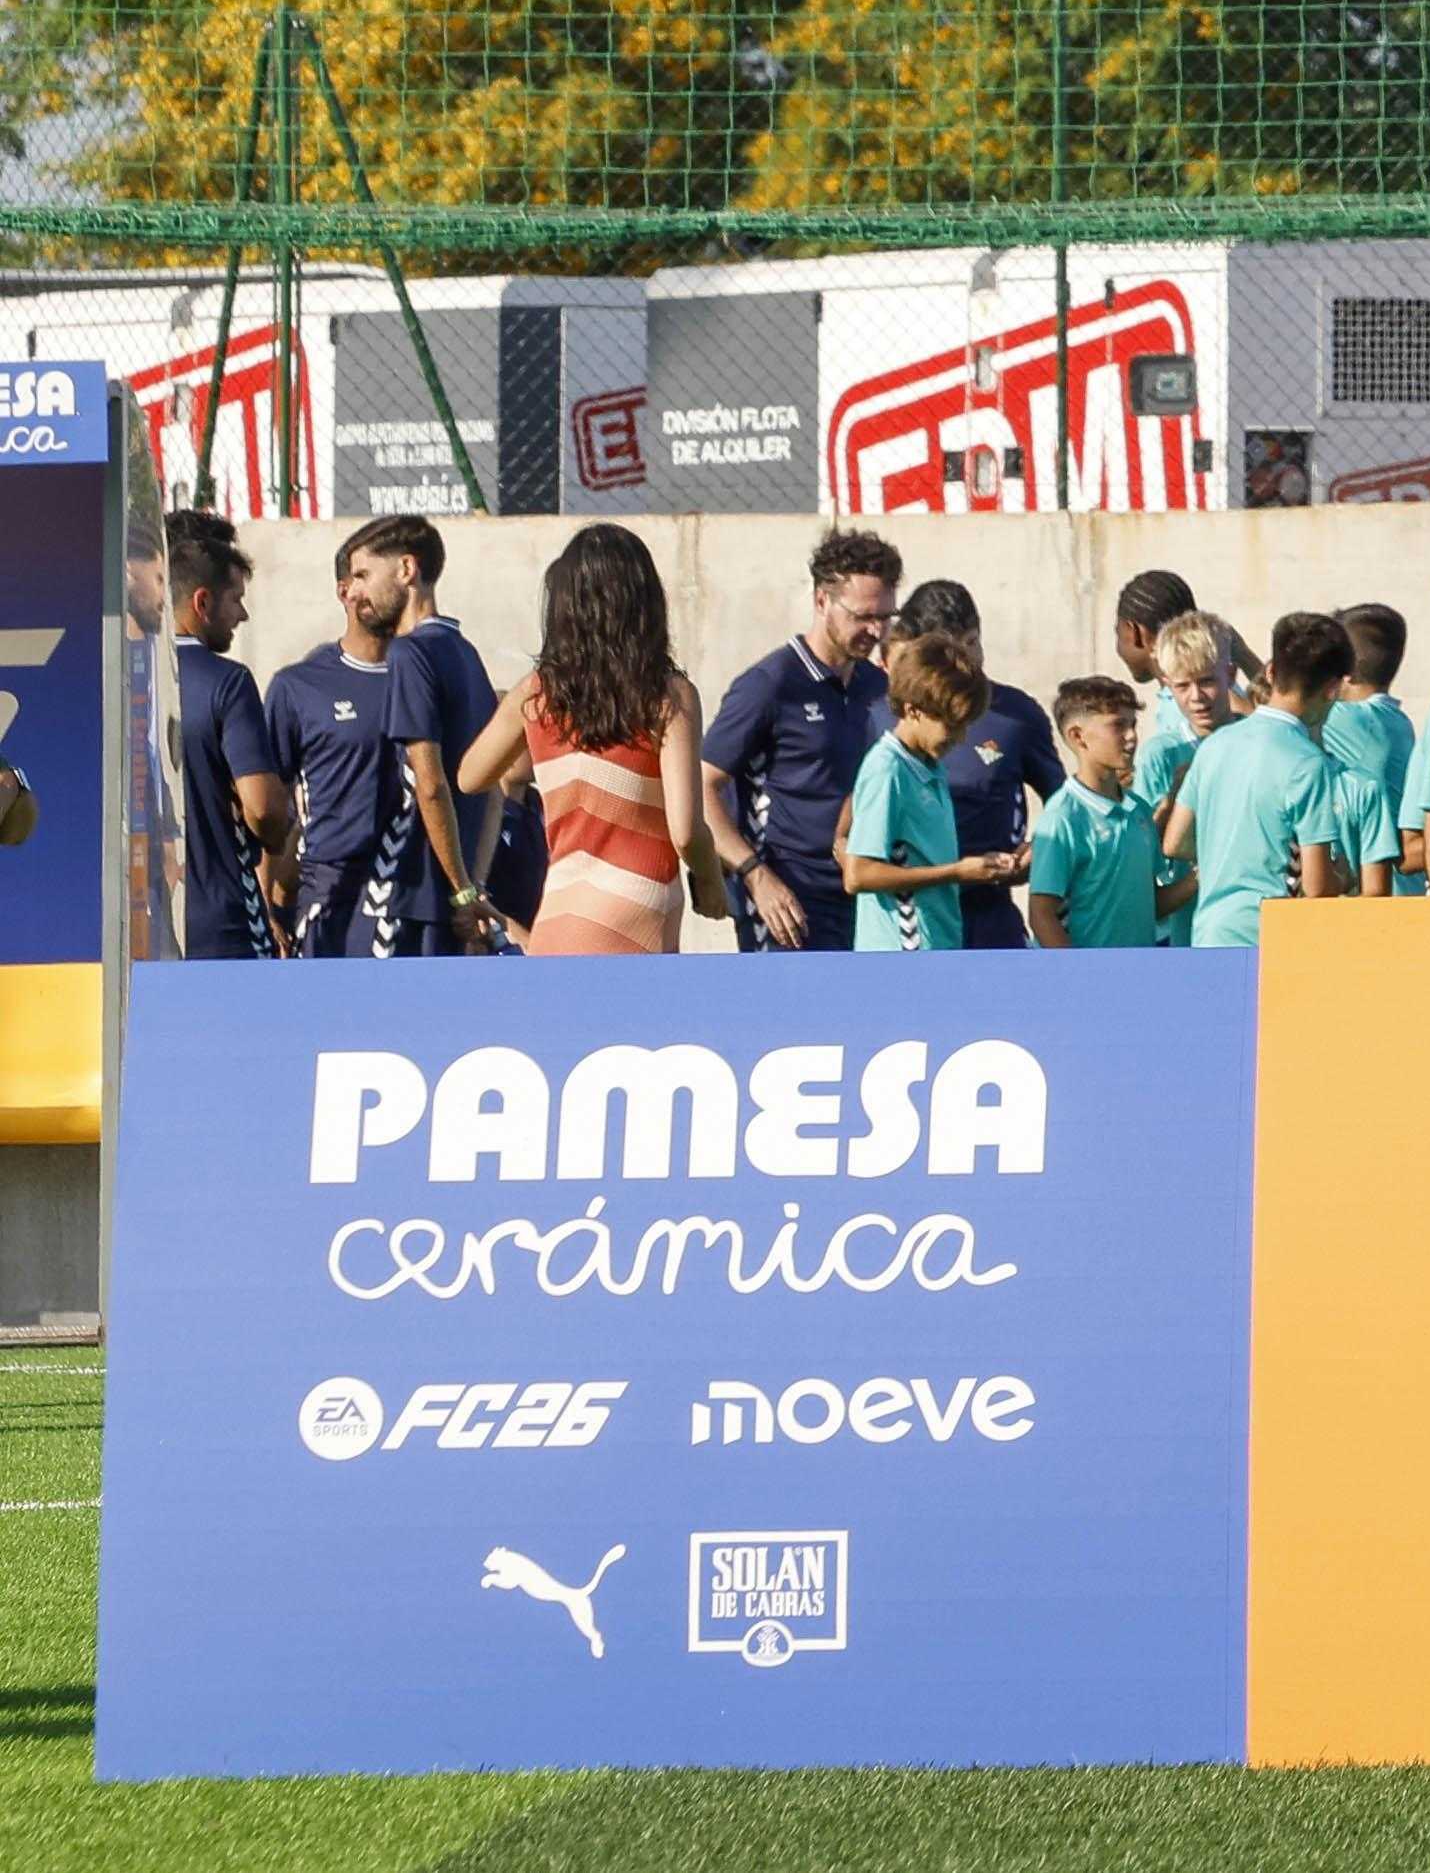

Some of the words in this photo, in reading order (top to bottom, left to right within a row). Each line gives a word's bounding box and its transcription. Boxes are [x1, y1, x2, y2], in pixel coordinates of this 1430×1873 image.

[662, 402, 739, 435] DIVISIÓN
[740, 405, 800, 431] FLOTA
[671, 439, 699, 465] DE
[700, 435, 792, 464] ALQUILER
[309, 1039, 1047, 1184] PAMESA
[327, 1196, 1018, 1300] cerámica
[315, 1396, 366, 1423] EA
[691, 1375, 1036, 1445] moeve
[312, 1423, 368, 1437] SPORTS
[711, 1591, 737, 1618] DE
[745, 1590, 826, 1617] CABRAS
